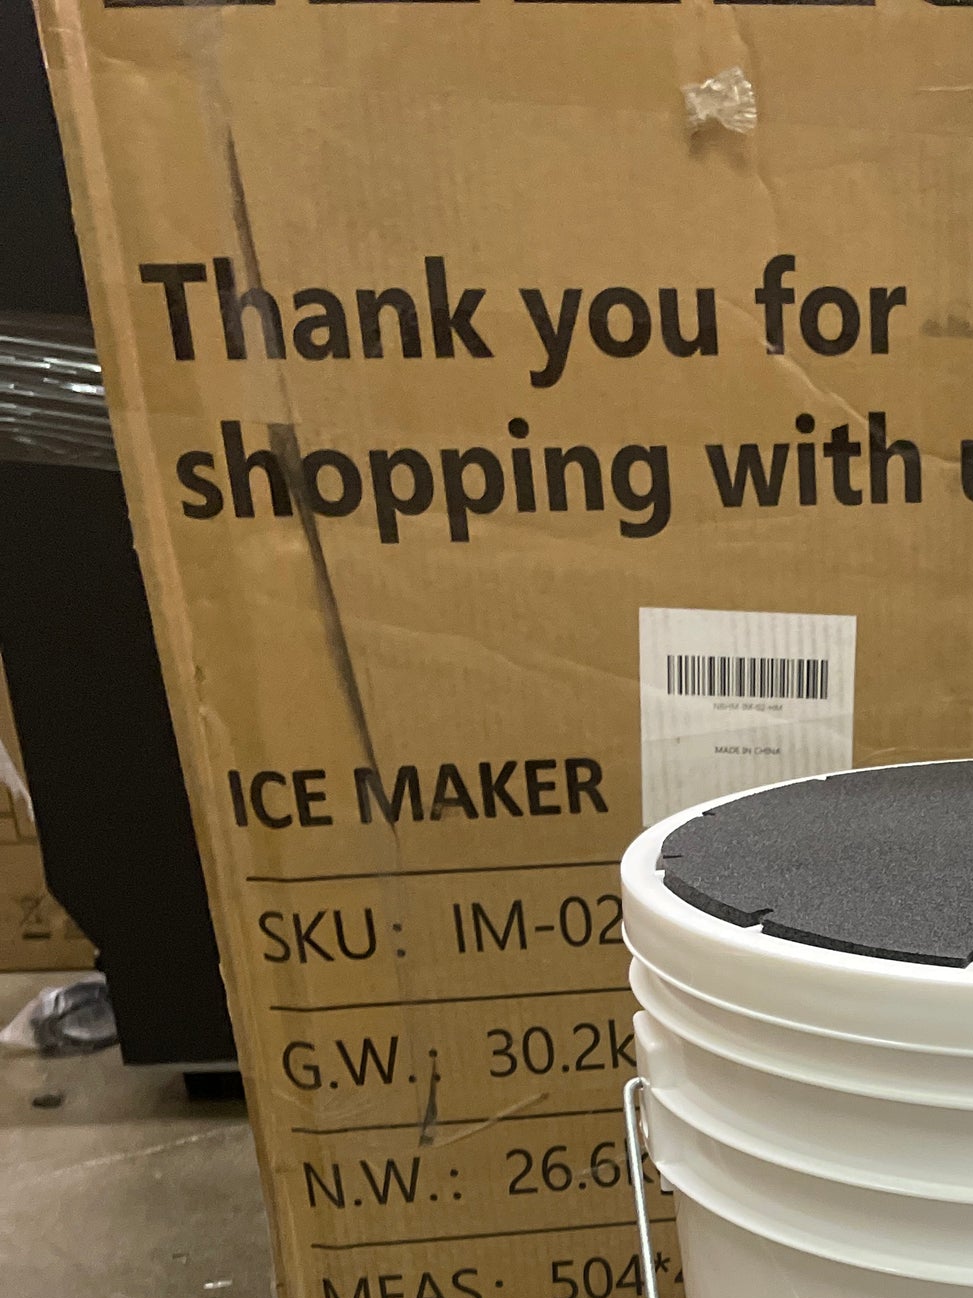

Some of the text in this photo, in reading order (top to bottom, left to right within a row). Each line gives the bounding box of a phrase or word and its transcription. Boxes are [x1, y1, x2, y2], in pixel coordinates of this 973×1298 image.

[139, 254, 906, 388] Thank you for
[176, 417, 672, 544] shopping
[706, 411, 923, 508] with
[227, 758, 609, 829] ICE MAKER
[258, 894, 624, 964] SKU: IM-02
[487, 1019, 637, 1078] 30.2k
[303, 1138, 674, 1210] N.W.: 26.6k
